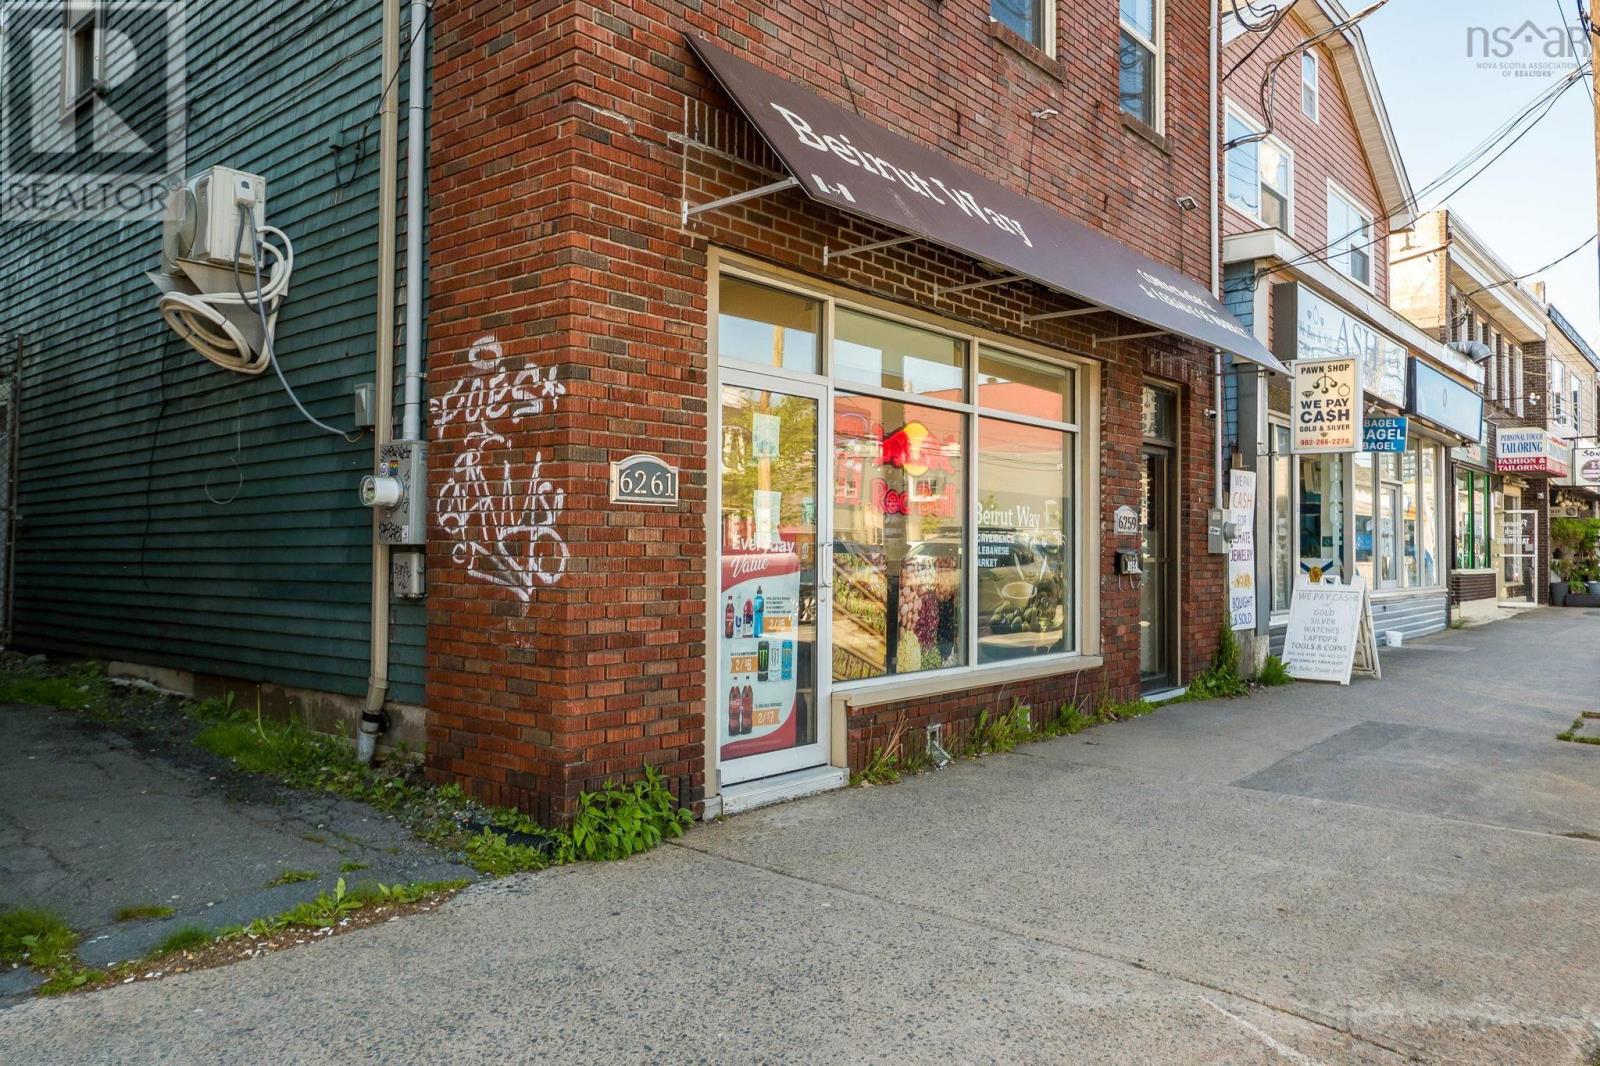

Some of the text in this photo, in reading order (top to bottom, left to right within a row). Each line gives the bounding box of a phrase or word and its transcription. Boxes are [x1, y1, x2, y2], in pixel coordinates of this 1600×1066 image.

[770, 102, 1033, 248] Beirut Way
[1300, 364, 1350, 375] PAWN SHOP
[1300, 398, 1350, 409] WE PAY
[1363, 419, 1398, 427] BAGEL
[1362, 429, 1405, 440] AGEL
[1362, 441, 1397, 450] BAGEL
[1502, 442, 1543, 454] TAILORING
[1498, 457, 1536, 465] FASHION
[1498, 464, 1545, 472] TAILORING
[620, 469, 674, 496] 6261
[1233, 491, 1252, 509] CASH
[977, 502, 1041, 533] Beirut Way
[1118, 515, 1137, 530] 6259
[977, 533, 1015, 544] ONVENIENCE
[978, 546, 1010, 555] LEBANESE
[730, 553, 769, 578] Value
[977, 558, 998, 567] ARKET
[1232, 595, 1253, 609] BOUGHT
[1298, 592, 1312, 600] WE
[1313, 592, 1331, 601] PAY
[1313, 608, 1336, 616] GOLD
[1239, 612, 1252, 625] SOLD
[1310, 617, 1336, 625] SILVER
[1291, 642, 1315, 650] TOOLS
[1323, 644, 1348, 652] COINS
